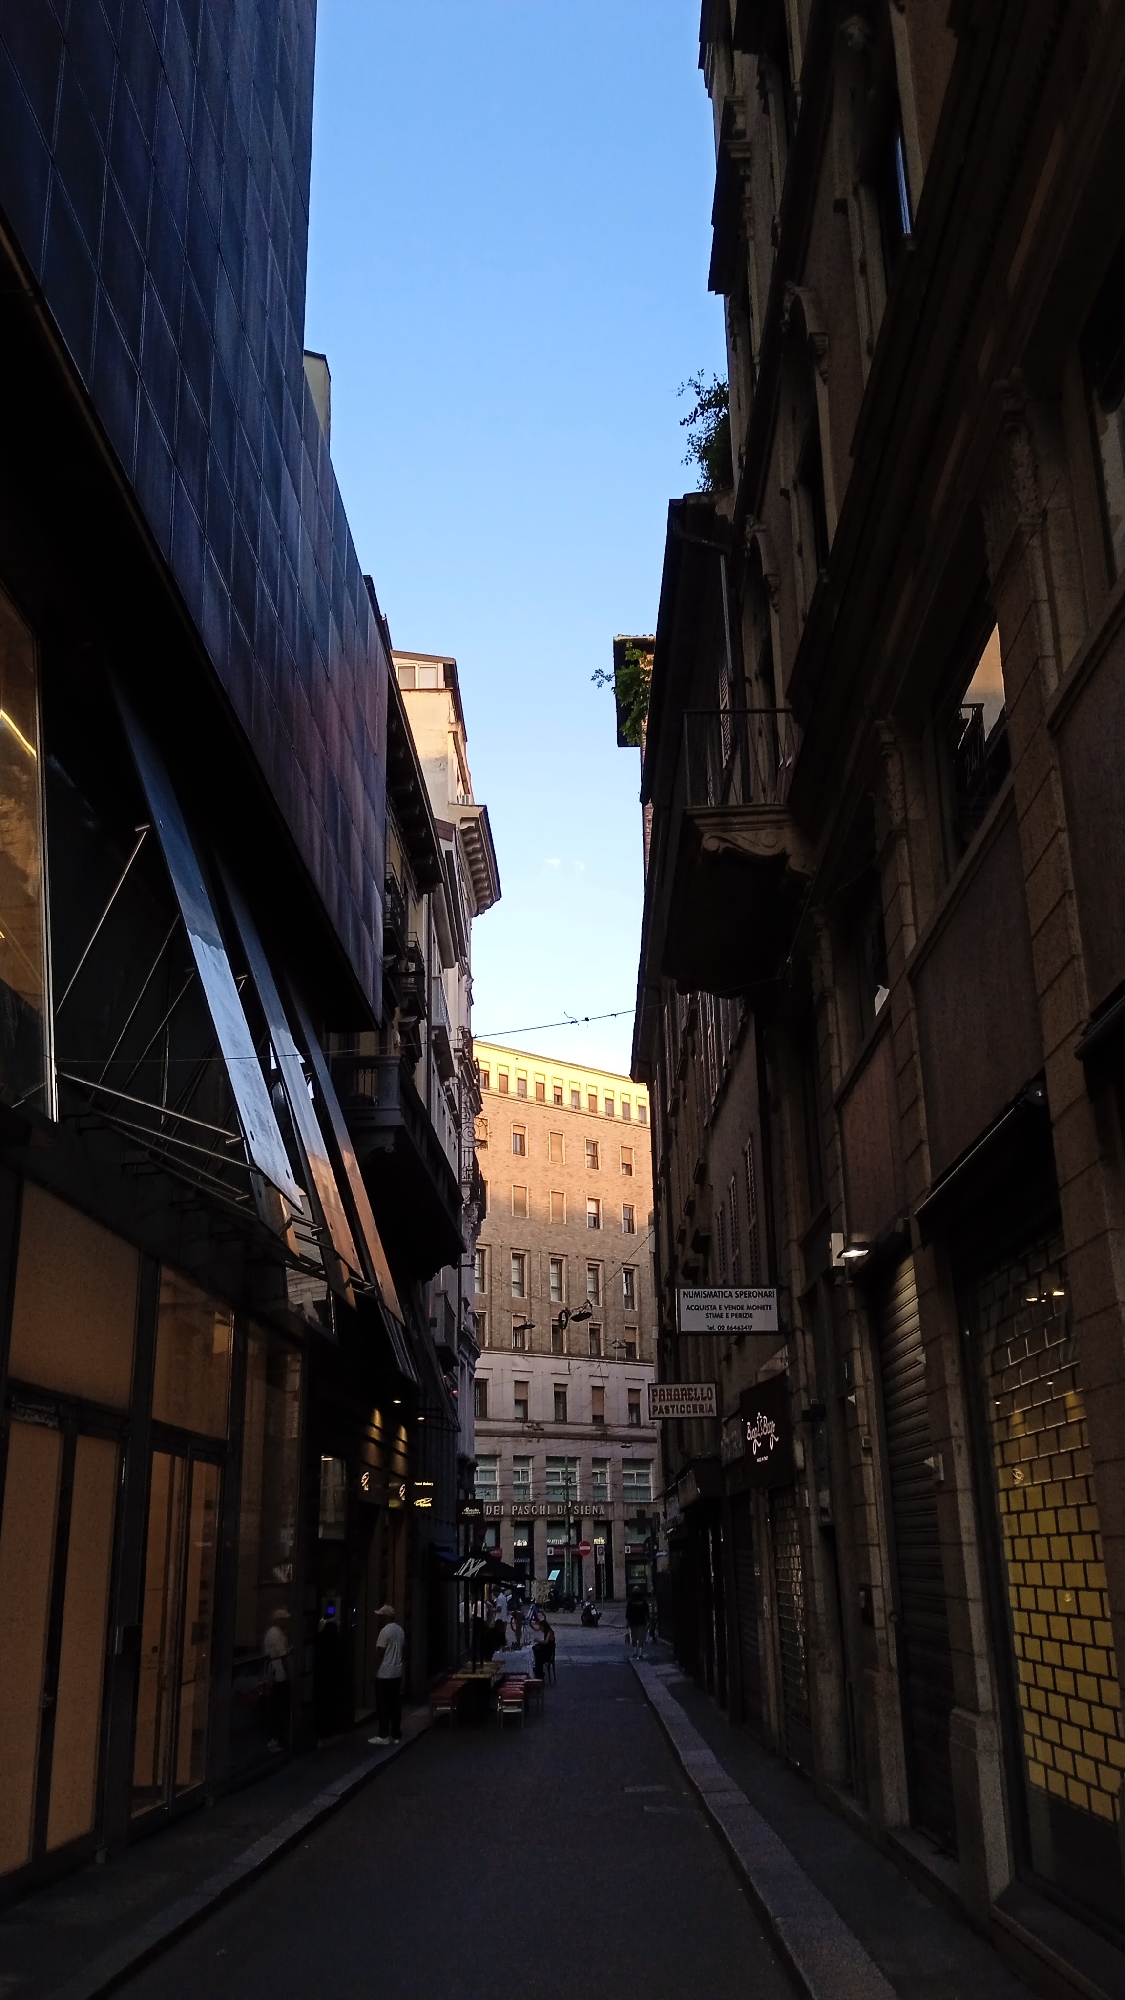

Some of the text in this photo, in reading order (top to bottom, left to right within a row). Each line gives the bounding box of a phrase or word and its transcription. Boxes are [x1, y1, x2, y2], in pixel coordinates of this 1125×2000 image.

[651, 1387, 713, 1402] PANARELLO
[652, 1404, 714, 1415] PASTICCERIA
[486, 1505, 504, 1515] DEI
[512, 1505, 550, 1515] PASCHI
[574, 1505, 605, 1515] SIENA
